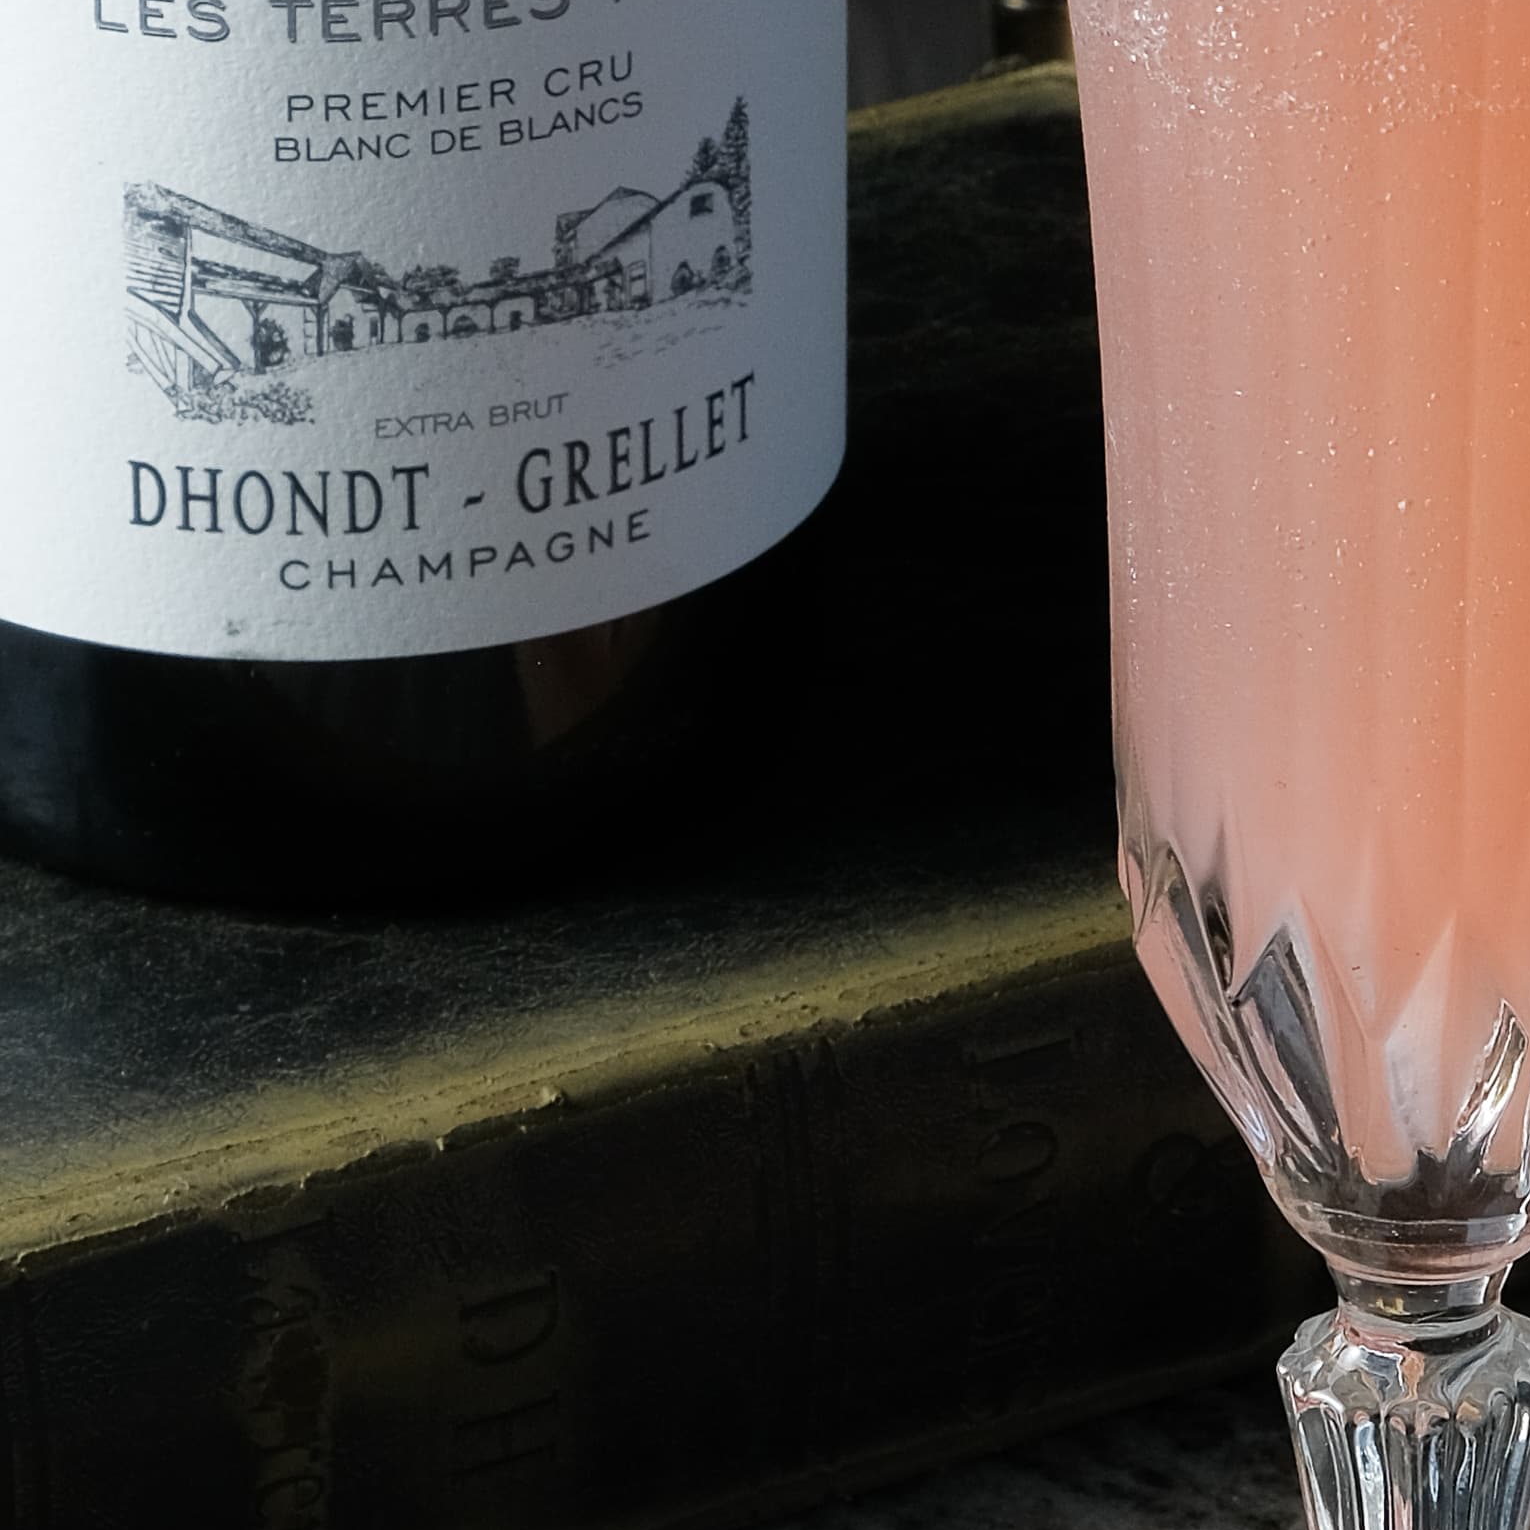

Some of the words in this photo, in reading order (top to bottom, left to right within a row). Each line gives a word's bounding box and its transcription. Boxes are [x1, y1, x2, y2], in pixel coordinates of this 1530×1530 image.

[286, 77, 517, 123] PREMIER
[543, 50, 633, 97] CRU
[274, 133, 411, 163] BLANC
[430, 125, 483, 156] DE
[499, 91, 643, 147] BLANCS
[374, 411, 475, 440] EXTRA
[488, 392, 569, 429] BRUT
[126, 459, 430, 538] DHONDT
[516, 370, 756, 514] GRELLET
[279, 509, 652, 592] CHAMPAGNE
